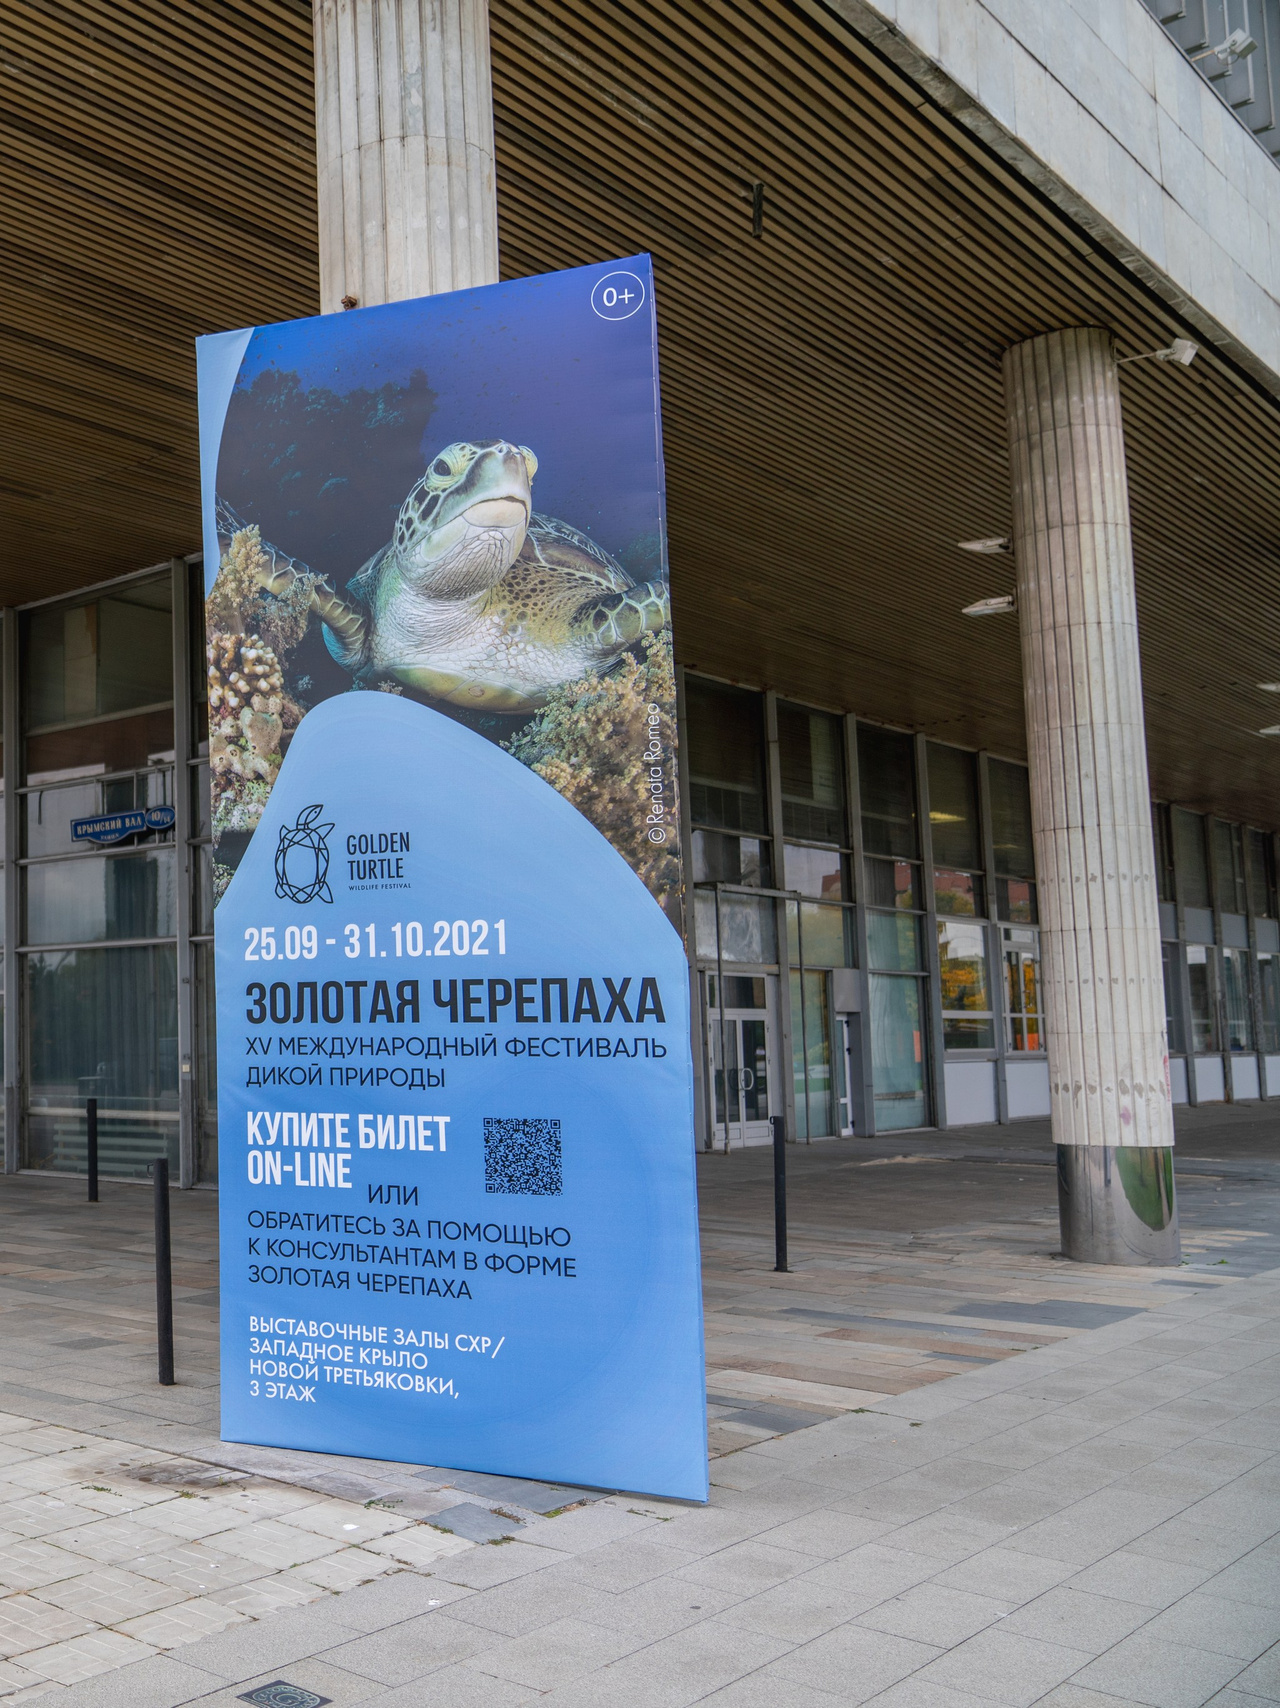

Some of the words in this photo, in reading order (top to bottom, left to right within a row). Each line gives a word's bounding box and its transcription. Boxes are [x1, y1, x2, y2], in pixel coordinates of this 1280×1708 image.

[603, 287, 635, 307] 0+
[643, 703, 661, 760] Romeo
[646, 767, 664, 824] Renata
[77, 818, 122, 835] КРЫМСКИЙ
[125, 816, 142, 828] ВАЛ
[346, 832, 410, 856] GOLDEN
[347, 858, 404, 880] TURTLE
[244, 924, 318, 961] 25.09
[343, 918, 507, 959] 31.10.2021
[245, 980, 420, 1025] ЗОЛОТАЯ
[432, 976, 667, 1024] ЧЕРЕПАХА
[245, 1037, 273, 1056] XV
[278, 1033, 498, 1060] МЕЖДУНАРОДНЫЙ
[504, 1036, 668, 1058] ФЕСТИВАЛЬ
[245, 1062, 323, 1088] ДИКОЙ
[329, 1067, 446, 1090] ПРИРОДЫ
[247, 1111, 352, 1149] КУПИТЕ
[358, 1113, 451, 1152] БИЛЕТ
[247, 1150, 353, 1189] ON-LINE
[368, 1184, 419, 1207] ИЛИ
[247, 1209, 386, 1236] ОБРАТИТЕСЬ
[392, 1217, 421, 1238] ЗА
[427, 1219, 572, 1249] ПОМОЩЬЮ
[248, 1237, 261, 1256] К
[266, 1238, 457, 1271] КОНСУЛЬТАНТАМ
[463, 1251, 478, 1271] В
[484, 1252, 577, 1278] ФОРМЕ
[248, 1264, 350, 1290] ЗОЛОТАЯ
[356, 1271, 473, 1300] ЧЕРЕПАХА
[249, 1315, 388, 1345] ВЫСТАВОЧНЫЕ
[392, 1328, 449, 1350] ЗАЛЫ
[249, 1337, 354, 1365] ЗАПАДНОЕ
[359, 1348, 428, 1370] КРЫЛО
[249, 1356, 319, 1382] НОВОЙ
[323, 1365, 460, 1400] ТРЕТЬЯКОВКИ,
[249, 1381, 260, 1397] 3
[265, 1382, 317, 1403] ЭТАЖ
